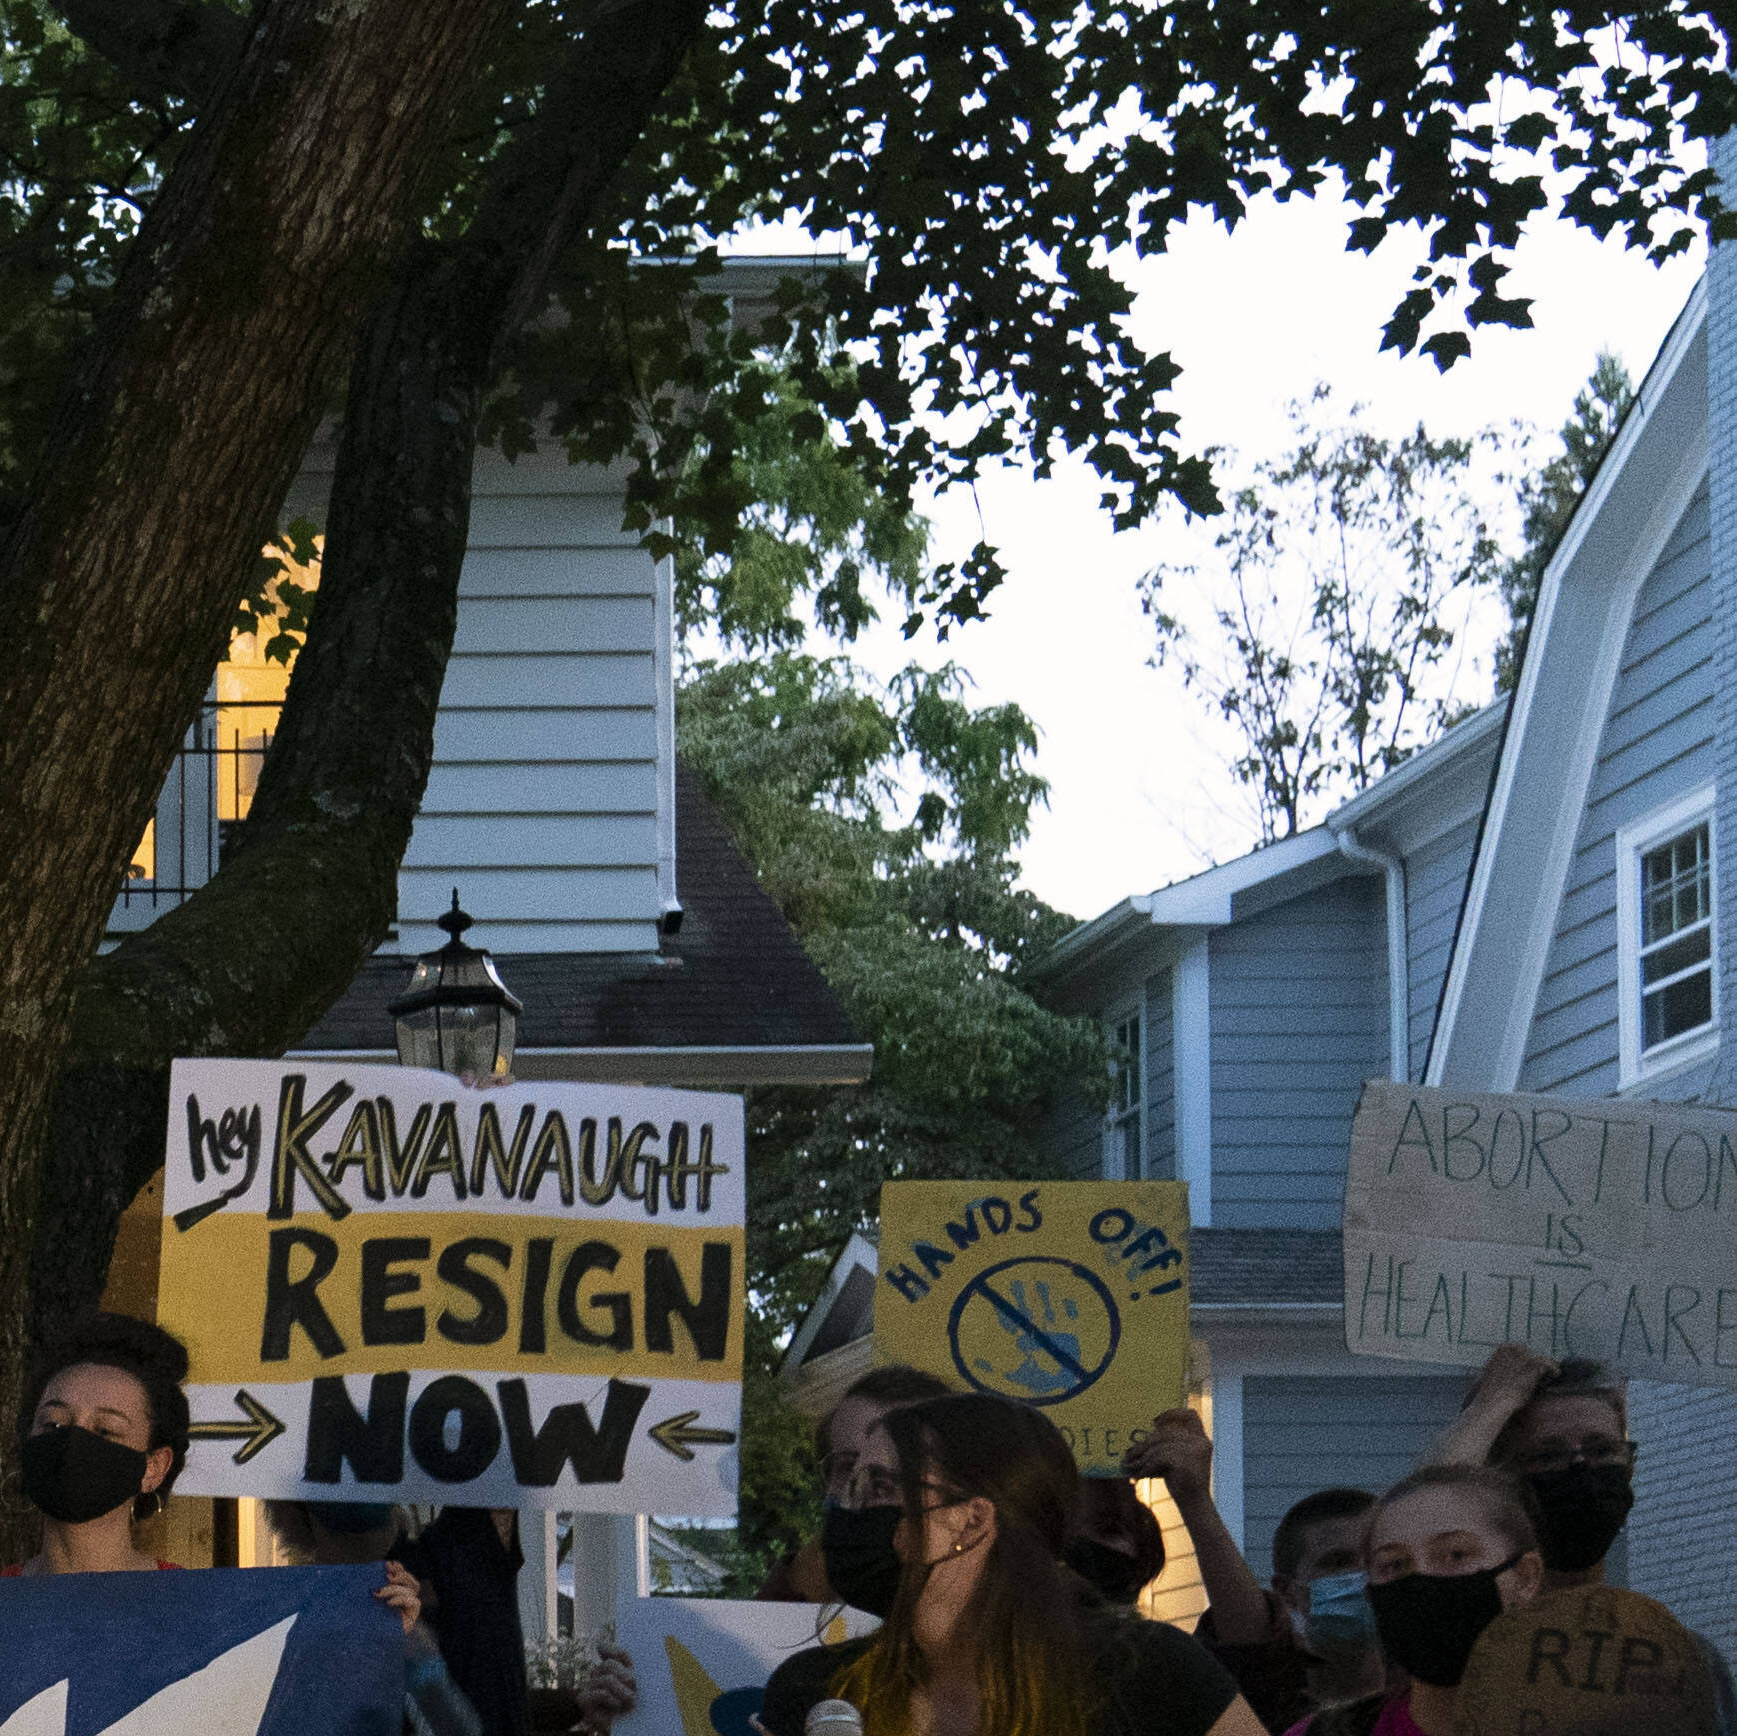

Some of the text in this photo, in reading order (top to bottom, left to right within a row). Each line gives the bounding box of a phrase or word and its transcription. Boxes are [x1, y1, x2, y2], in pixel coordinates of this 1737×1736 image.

[173, 1072, 731, 1232] hey KAVANAUGH
[884, 1189, 1182, 1305] HANDS OFF!
[1545, 1213, 1585, 1257] IS
[259, 1226, 733, 1364] RESIGN
[1360, 1252, 1737, 1370] HEALTHCARE
[301, 1371, 653, 1488] NOW
